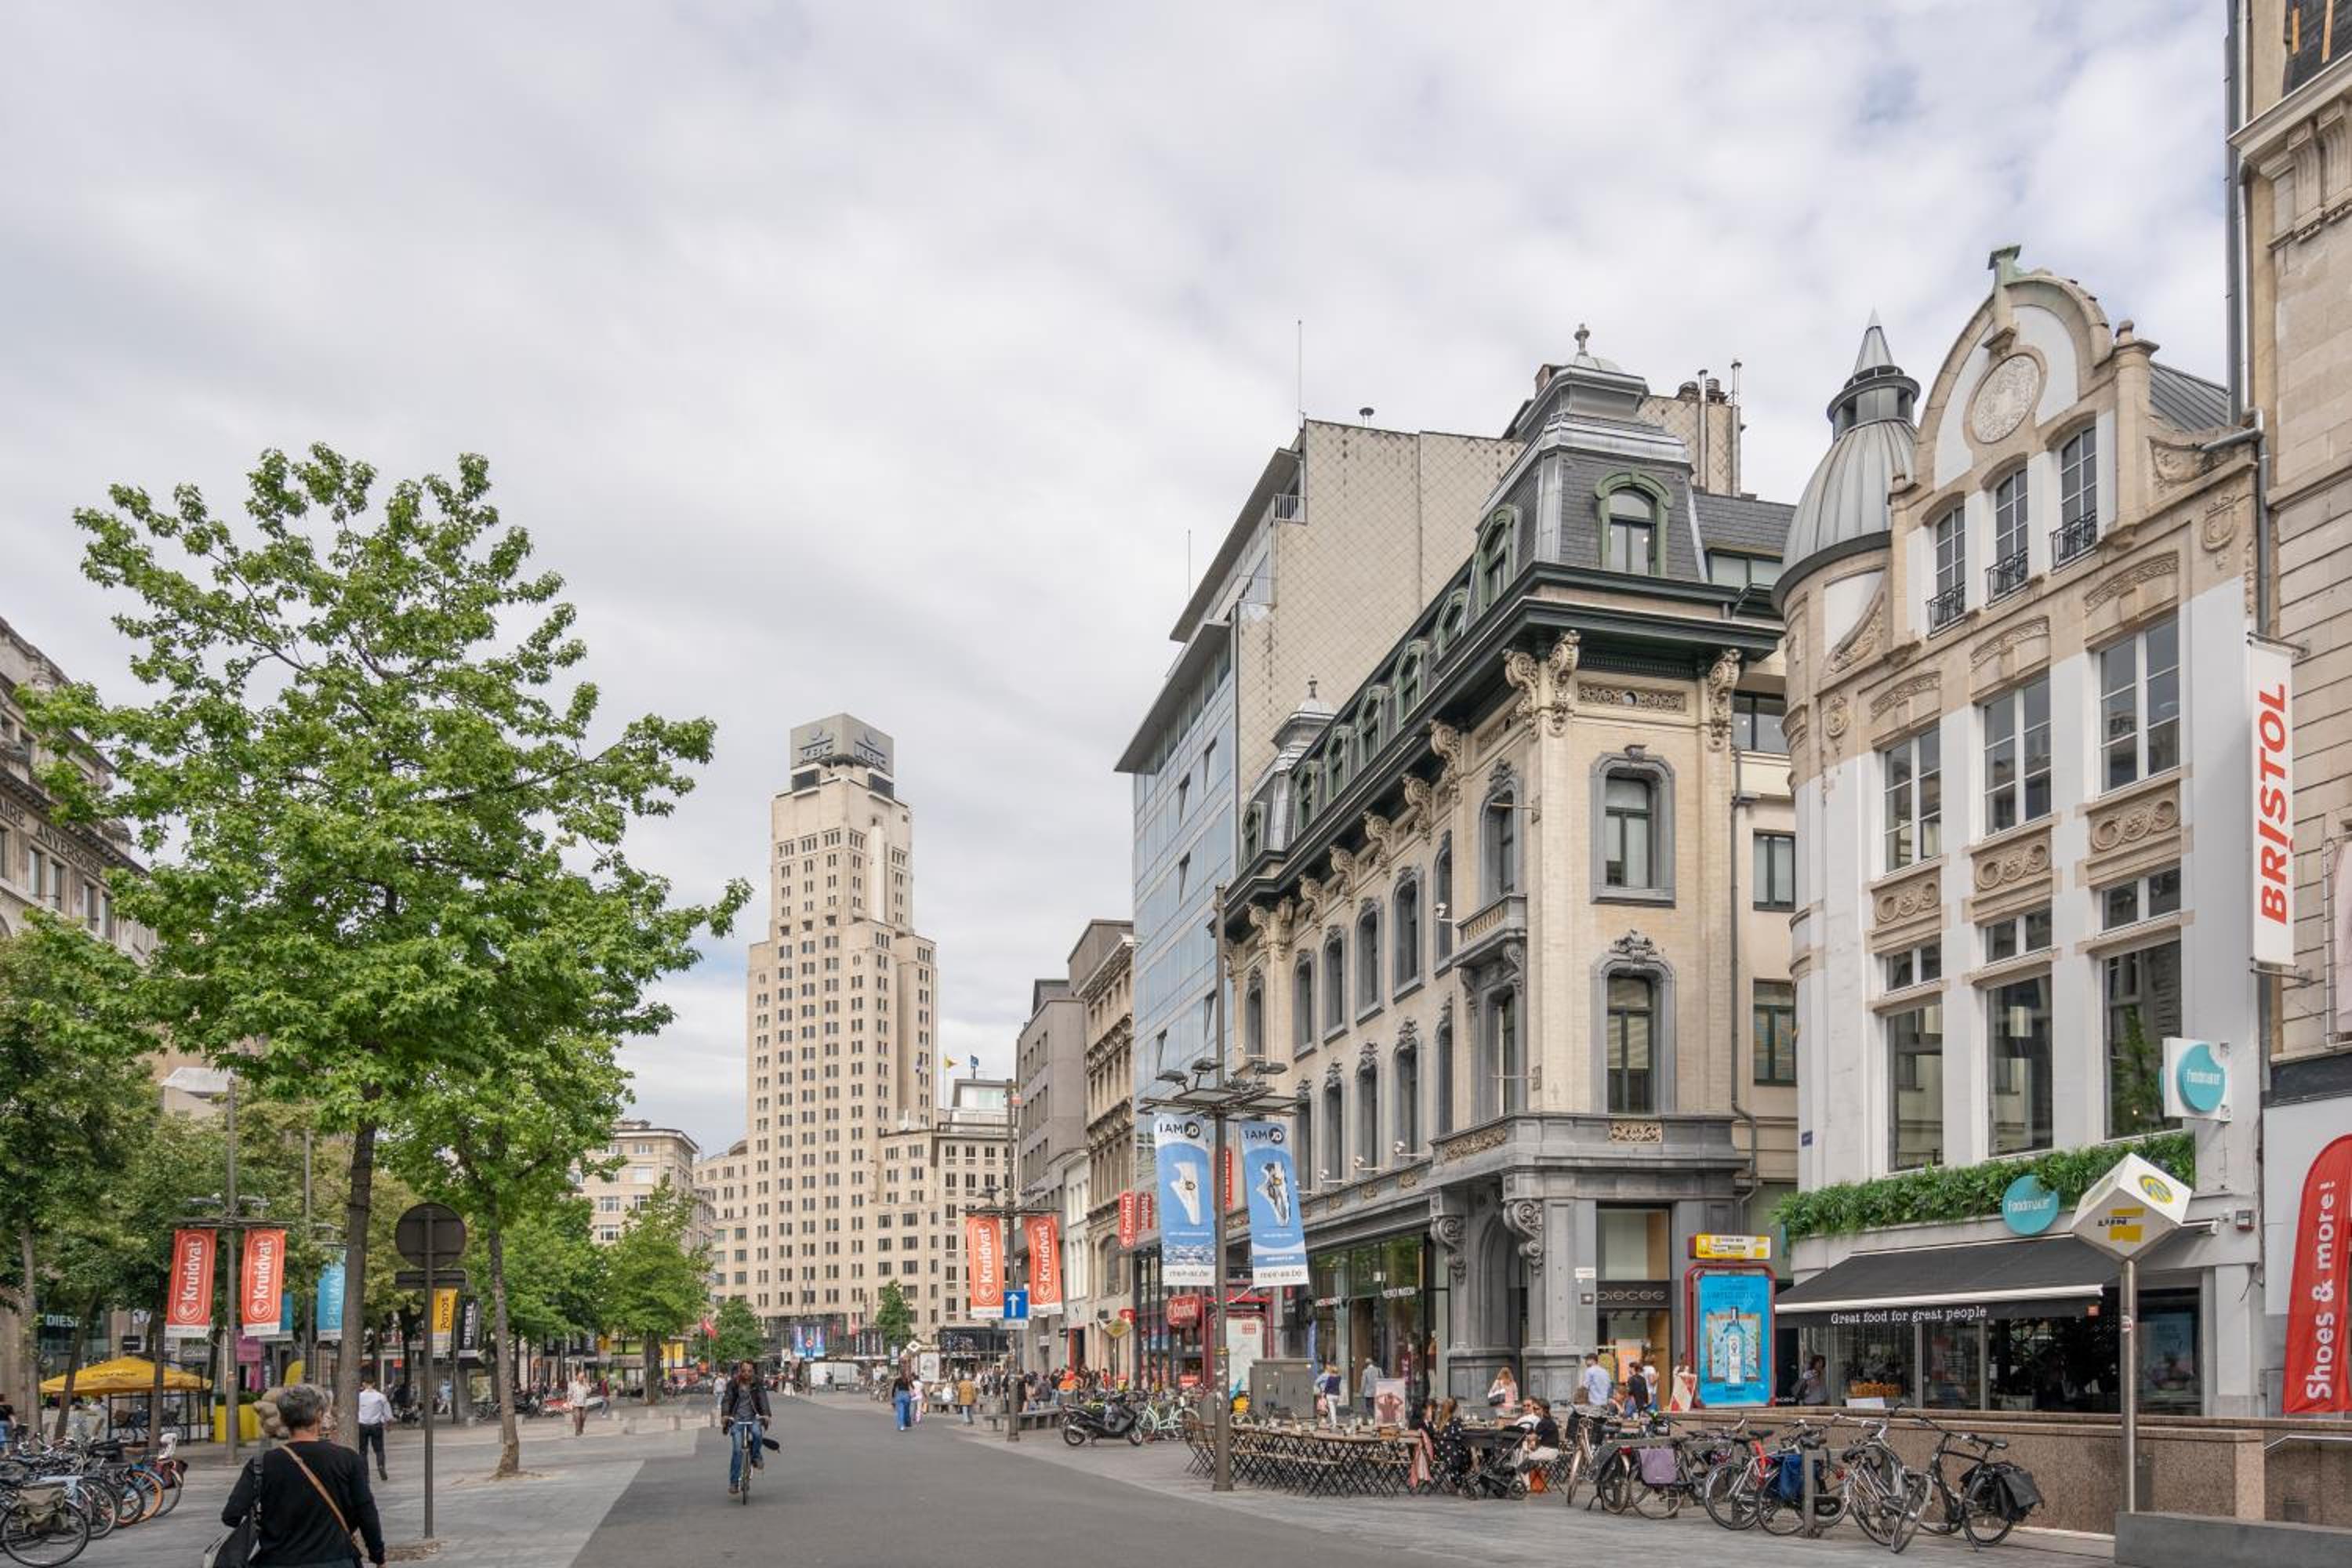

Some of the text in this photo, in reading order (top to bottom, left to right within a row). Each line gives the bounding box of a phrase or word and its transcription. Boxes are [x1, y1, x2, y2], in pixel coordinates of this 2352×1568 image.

[2259, 683, 2287, 925] BRISTOL
[1164, 1124, 1183, 1134] AM
[1249, 1131, 1268, 1140] AM
[181, 1241, 202, 1301] Kruidvat
[252, 1240, 273, 1299] Kruidvat
[978, 1228, 993, 1284] Kruidvat
[1036, 1225, 1051, 1282] Kruidvat
[441, 1296, 451, 1330] Panos
[1831, 1301, 1987, 1324] Great food for great people
[2306, 1181, 2336, 1400] Shoes & more!
[463, 1302, 474, 1345] DIESEL
